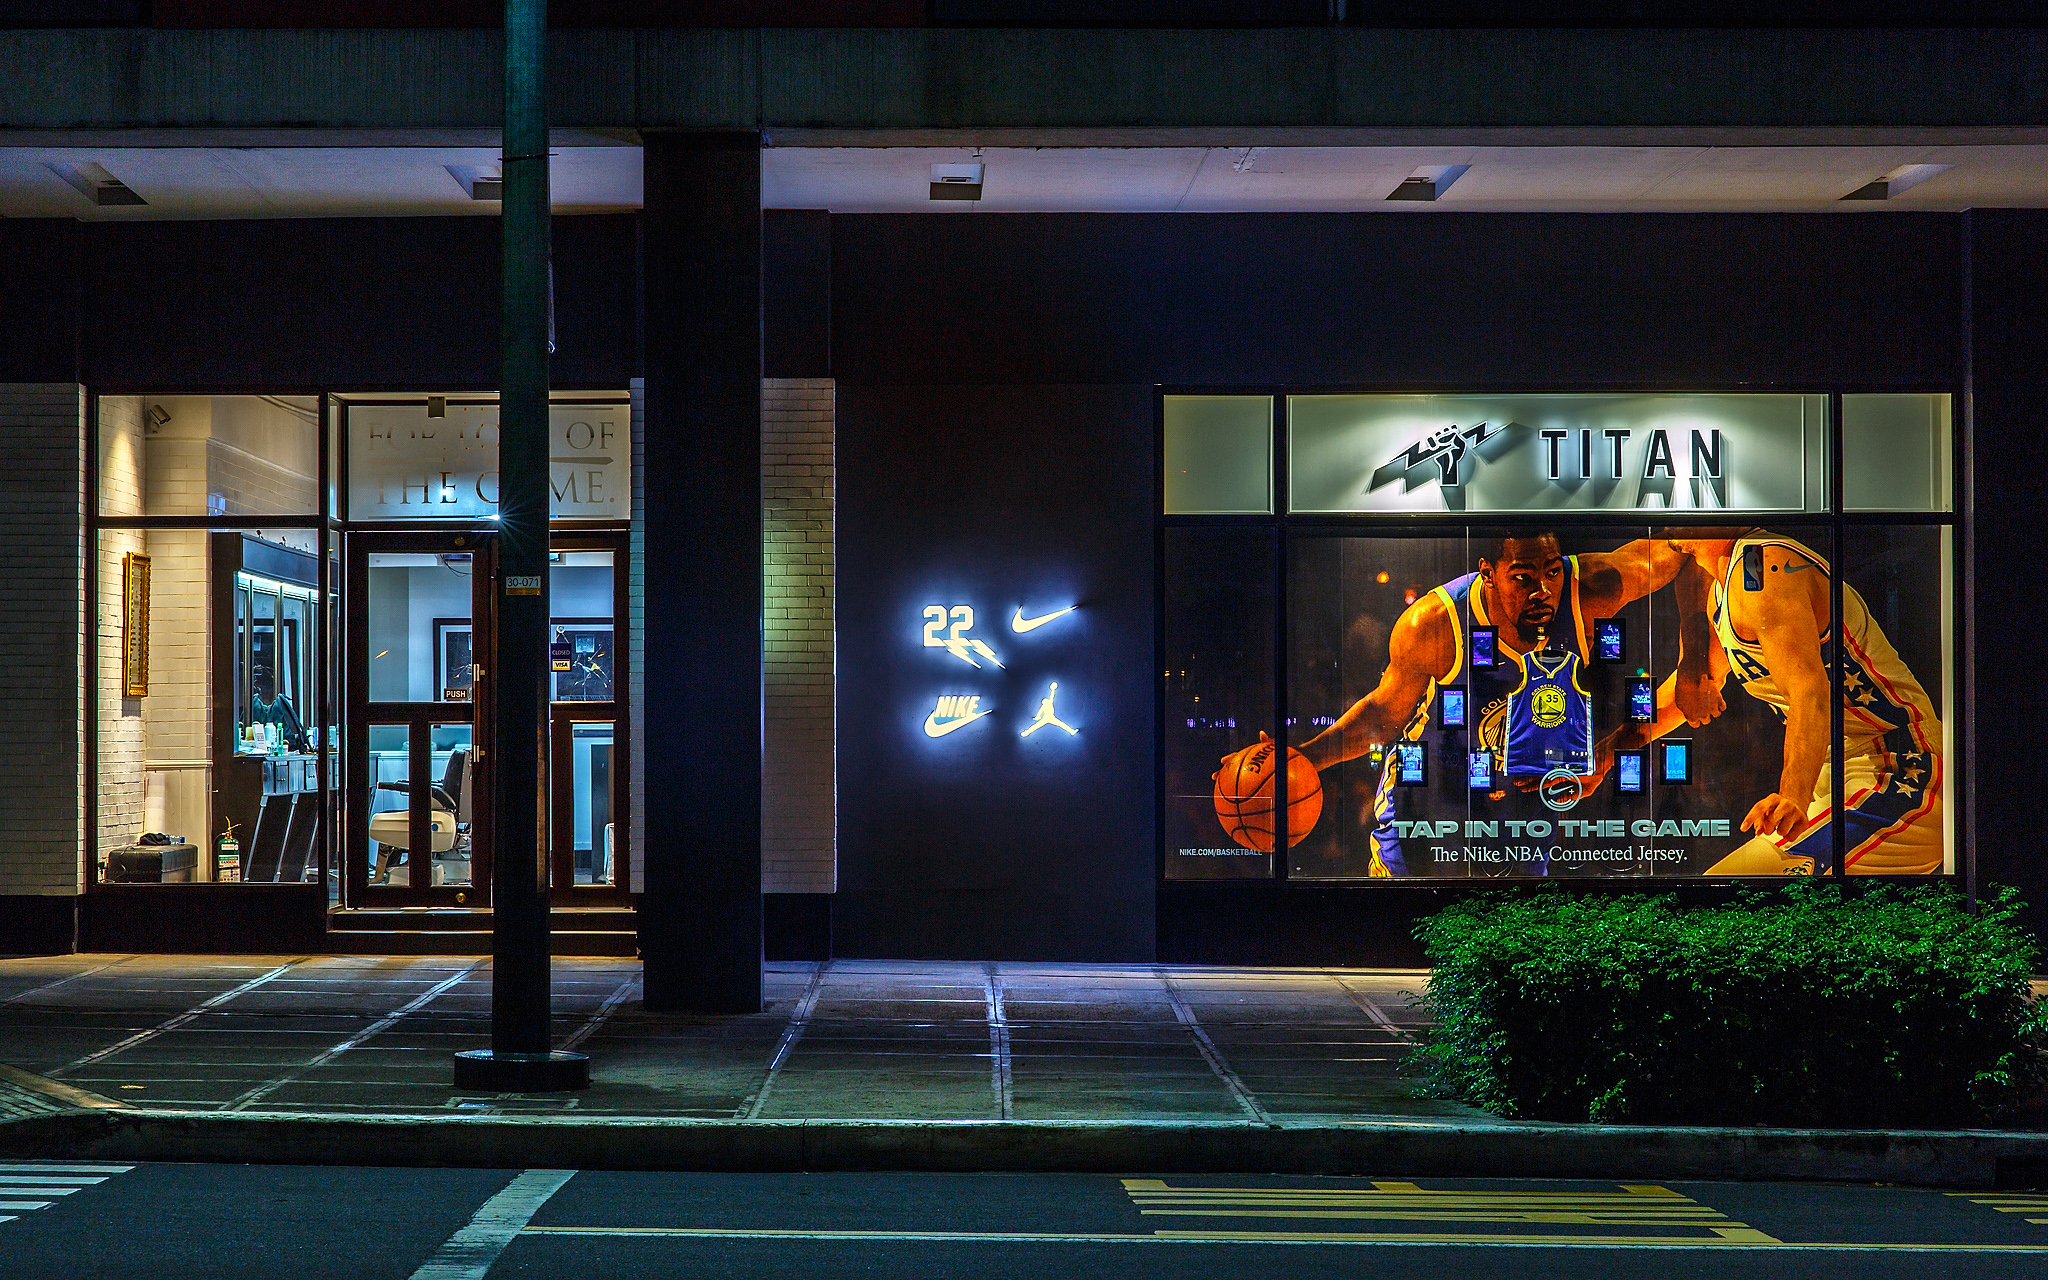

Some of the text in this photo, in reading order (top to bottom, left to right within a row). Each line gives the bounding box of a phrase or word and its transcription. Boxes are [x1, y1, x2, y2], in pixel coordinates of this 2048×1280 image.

[566, 421, 615, 450] OF
[1539, 428, 1722, 479] TITAN
[373, 470, 615, 505] THE GME.
[507, 577, 539, 587] 30-071
[1746, 580, 1757, 589] NBA
[923, 605, 974, 648] 22
[446, 690, 466, 698] PUSH
[1545, 694, 1559, 703] 35
[934, 695, 981, 718] NIKE
[1481, 694, 1509, 716] GOL
[1531, 715, 1567, 728] WARRIORS
[1392, 819, 1731, 838] TAP IN TO THE GAME
[1179, 848, 1263, 857] NIKE.COM/BASKETBALL
[1430, 845, 1688, 865] The Nike NBA Connected Jersey.
